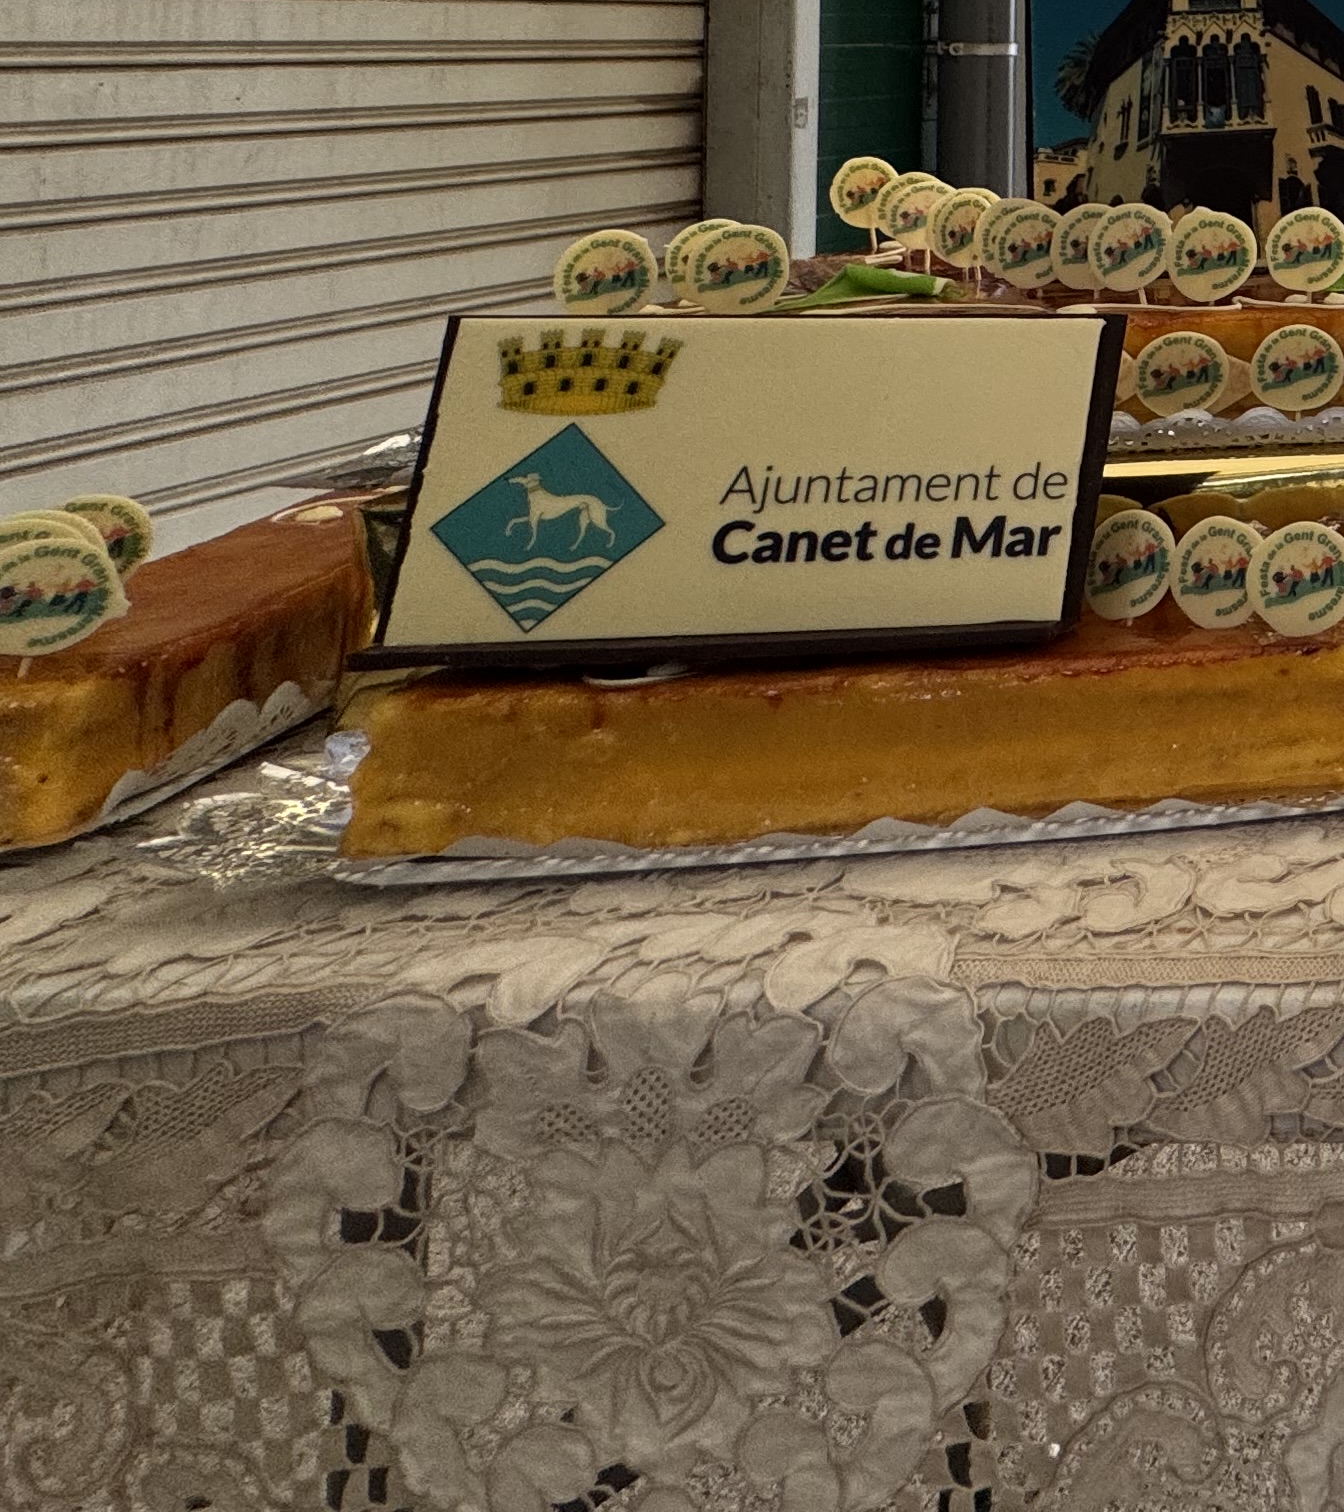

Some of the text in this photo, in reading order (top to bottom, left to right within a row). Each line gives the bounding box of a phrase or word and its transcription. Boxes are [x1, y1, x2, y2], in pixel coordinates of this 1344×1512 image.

[719, 461, 1068, 511] Ajuntament de
[711, 516, 1061, 565] Canet de Mar
